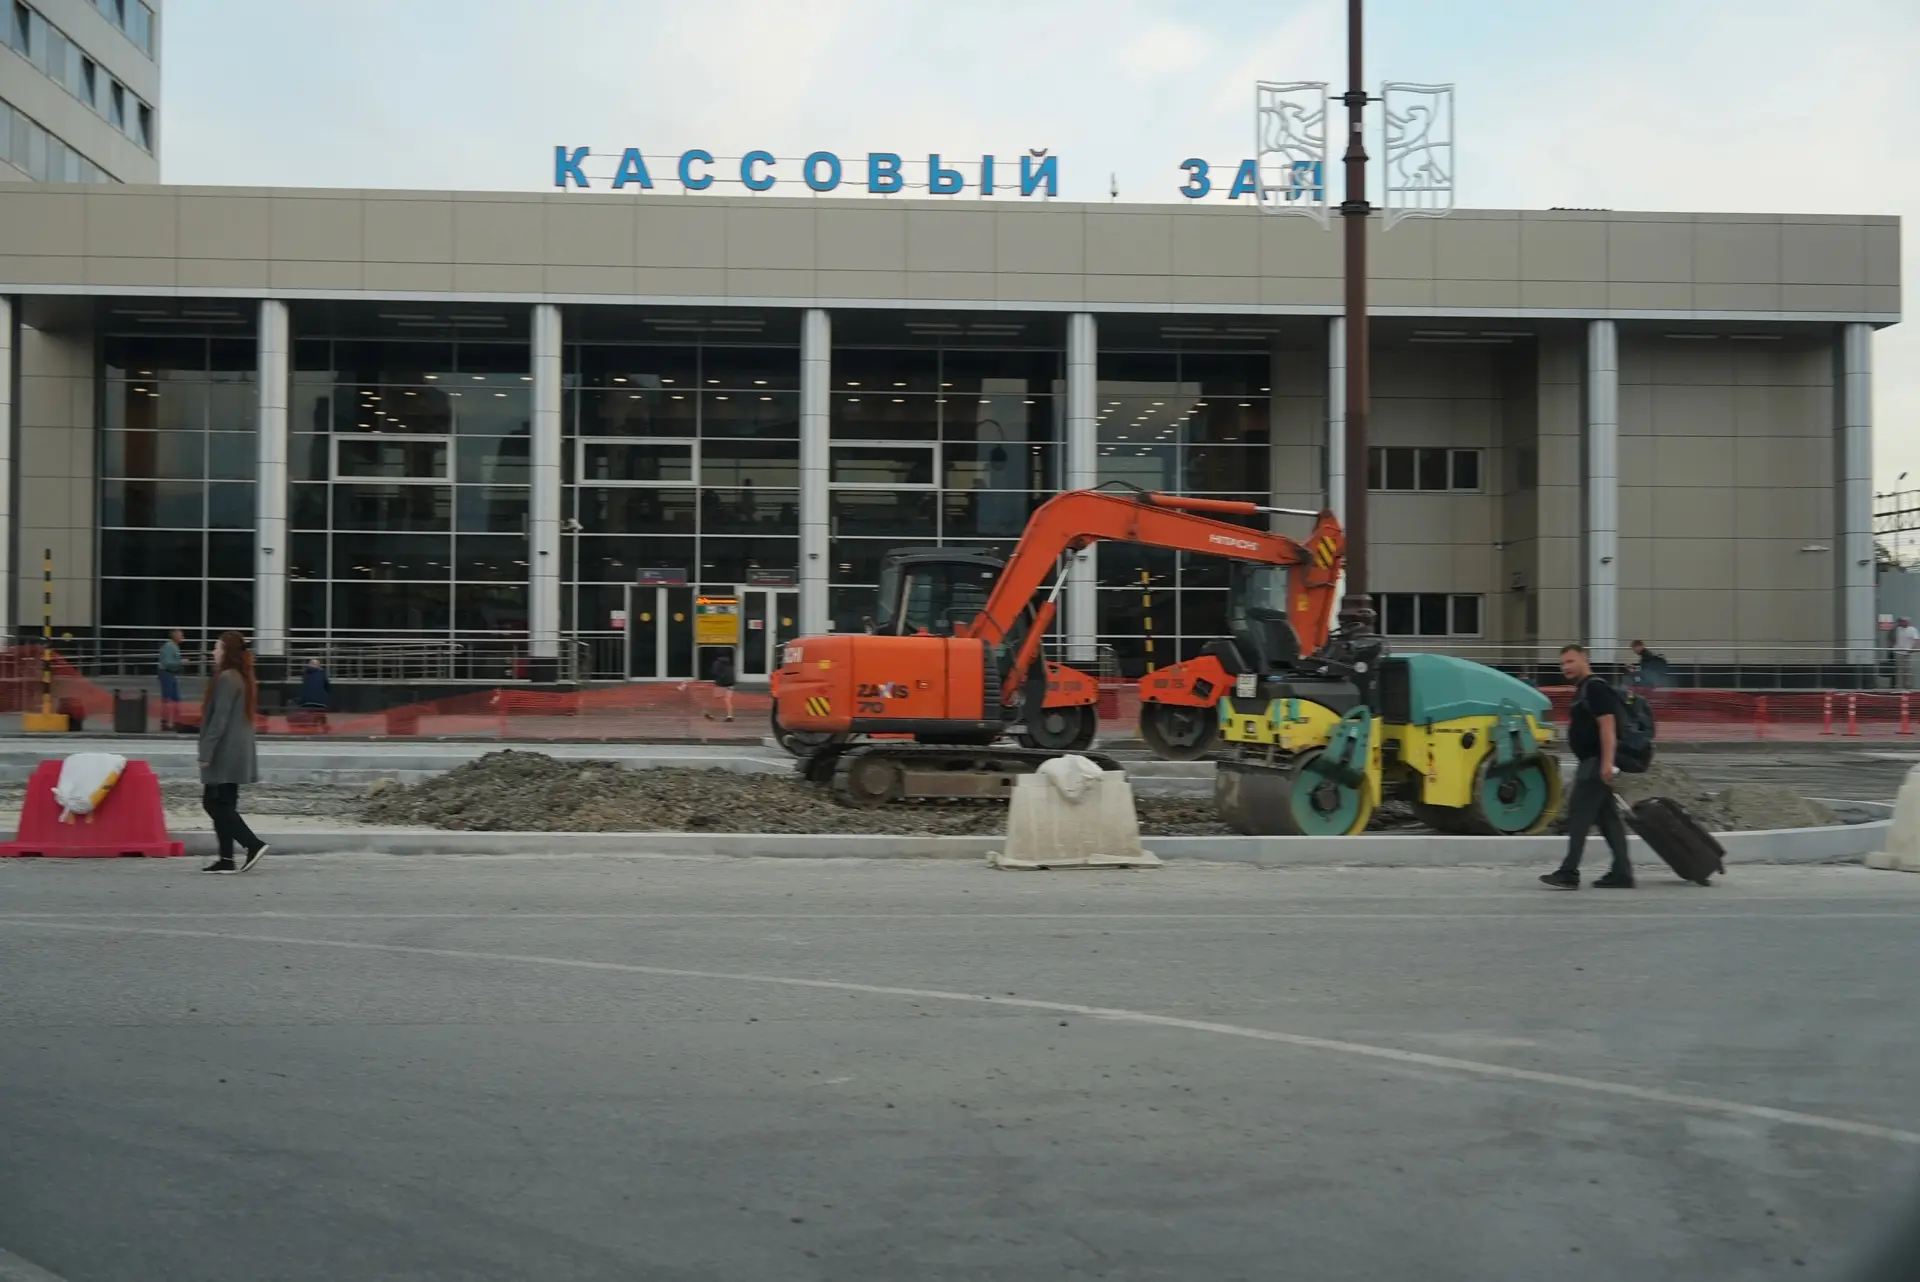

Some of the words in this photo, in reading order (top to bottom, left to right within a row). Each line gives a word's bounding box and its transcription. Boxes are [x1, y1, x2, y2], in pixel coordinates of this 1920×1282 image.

[554, 146, 1058, 197] КАССОВЫЙ
[1179, 158, 1326, 202] ЗАЛ
[857, 682, 909, 699] ZAXIS
